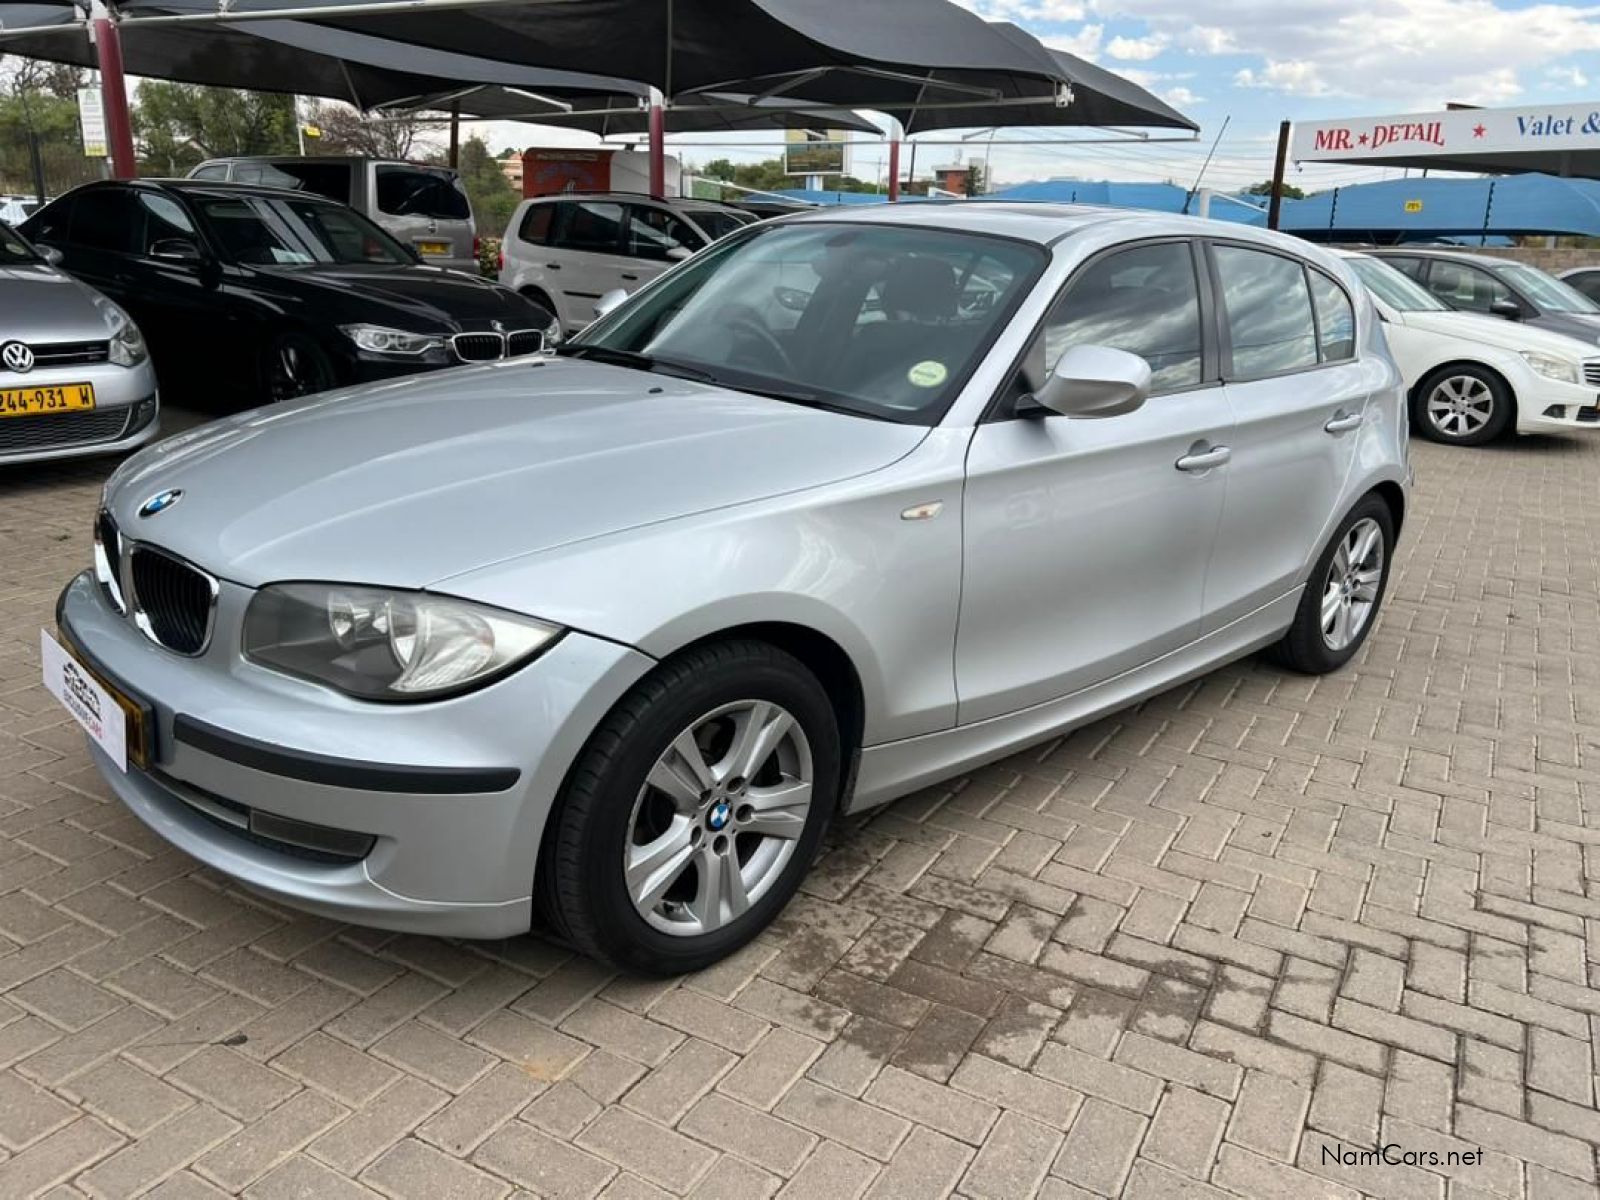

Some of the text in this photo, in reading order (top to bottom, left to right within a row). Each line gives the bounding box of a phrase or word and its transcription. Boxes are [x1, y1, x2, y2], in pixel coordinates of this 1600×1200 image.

[1315, 122, 1445, 150] MR. DETAIL
[1517, 114, 1573, 136] Valet
[79, 386, 91, 406] W
